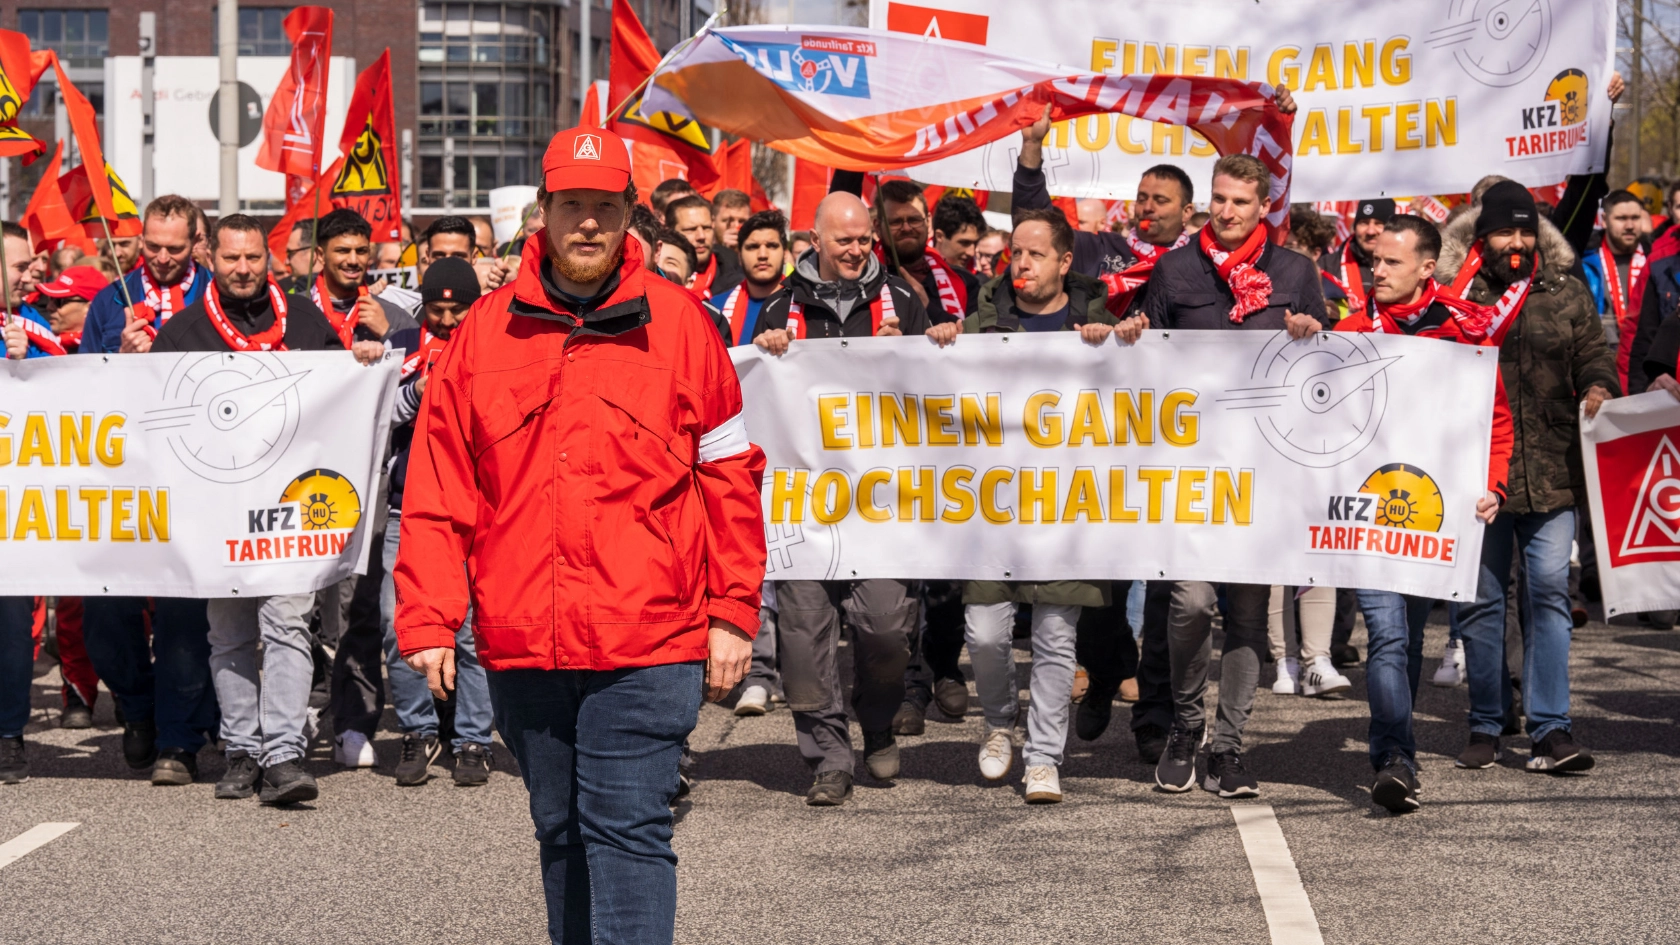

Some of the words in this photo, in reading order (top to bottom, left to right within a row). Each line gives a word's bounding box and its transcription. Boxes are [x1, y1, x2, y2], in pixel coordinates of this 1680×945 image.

[1266, 34, 1413, 93] GANG
[1522, 104, 1557, 130] KFZ
[1505, 121, 1587, 157] TARIFRUNE
[818, 391, 1005, 451] EINEN
[1022, 388, 1201, 449] GANG
[0, 485, 171, 543] ALTEN
[770, 465, 1256, 527] HOCHSCHALTEN
[1328, 495, 1373, 521] KFZ
[1389, 504, 1406, 516] HU
[248, 506, 296, 533] KFZ
[312, 508, 326, 518] HU
[226, 531, 354, 562] TARIFRUN
[1308, 525, 1456, 562] TARIFRUNDE
